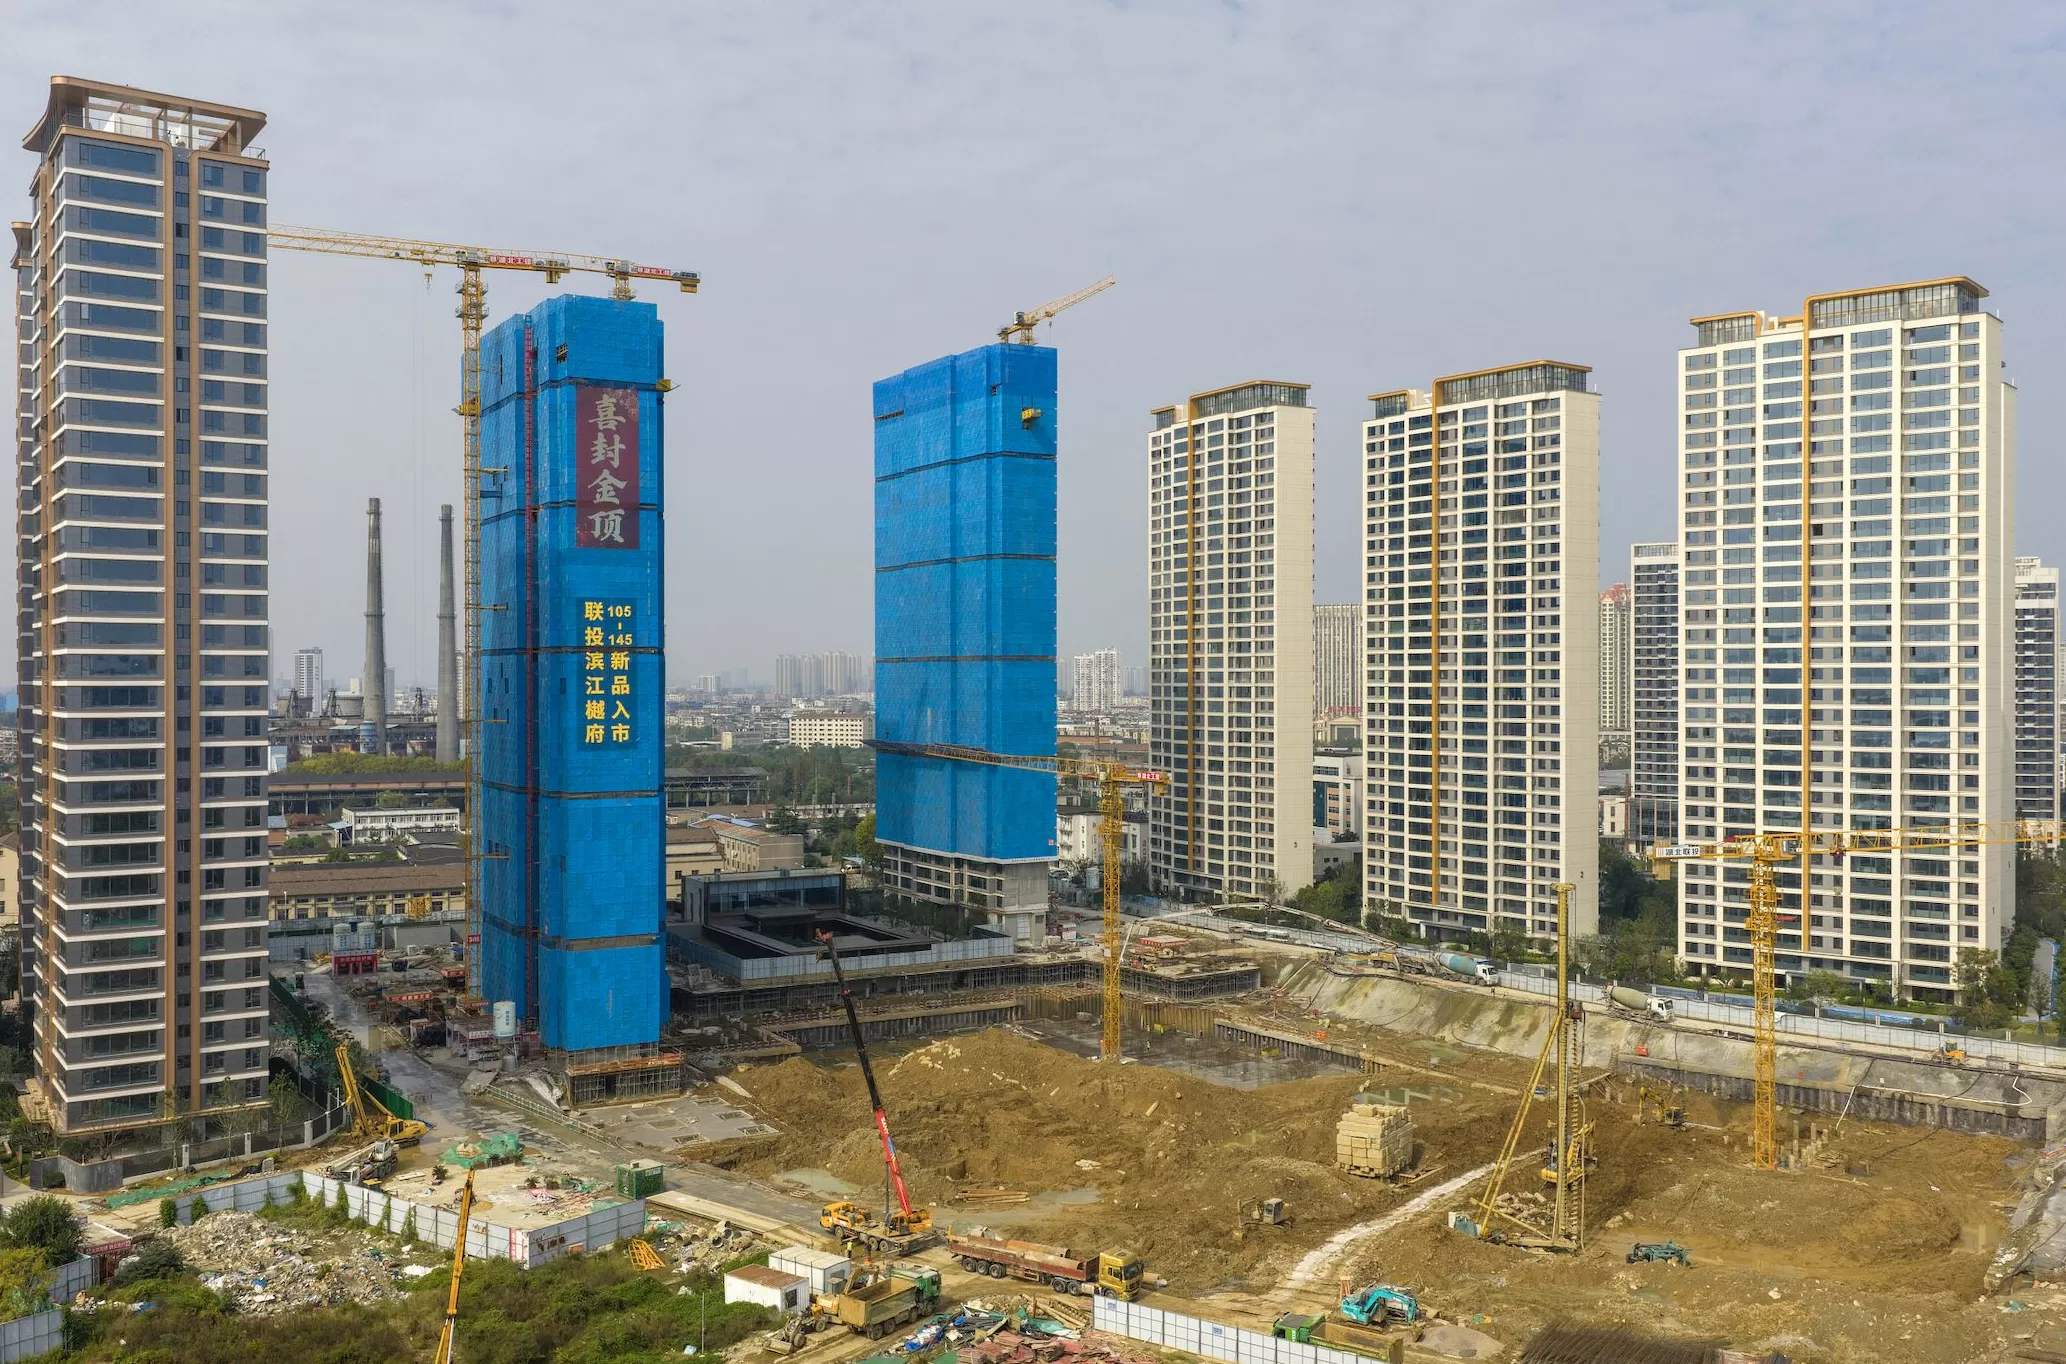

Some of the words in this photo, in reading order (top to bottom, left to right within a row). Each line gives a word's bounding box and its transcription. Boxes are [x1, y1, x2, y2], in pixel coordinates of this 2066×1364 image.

[588, 393, 628, 544] 喜封金顶
[584, 601, 605, 743] 联投滨江樾府
